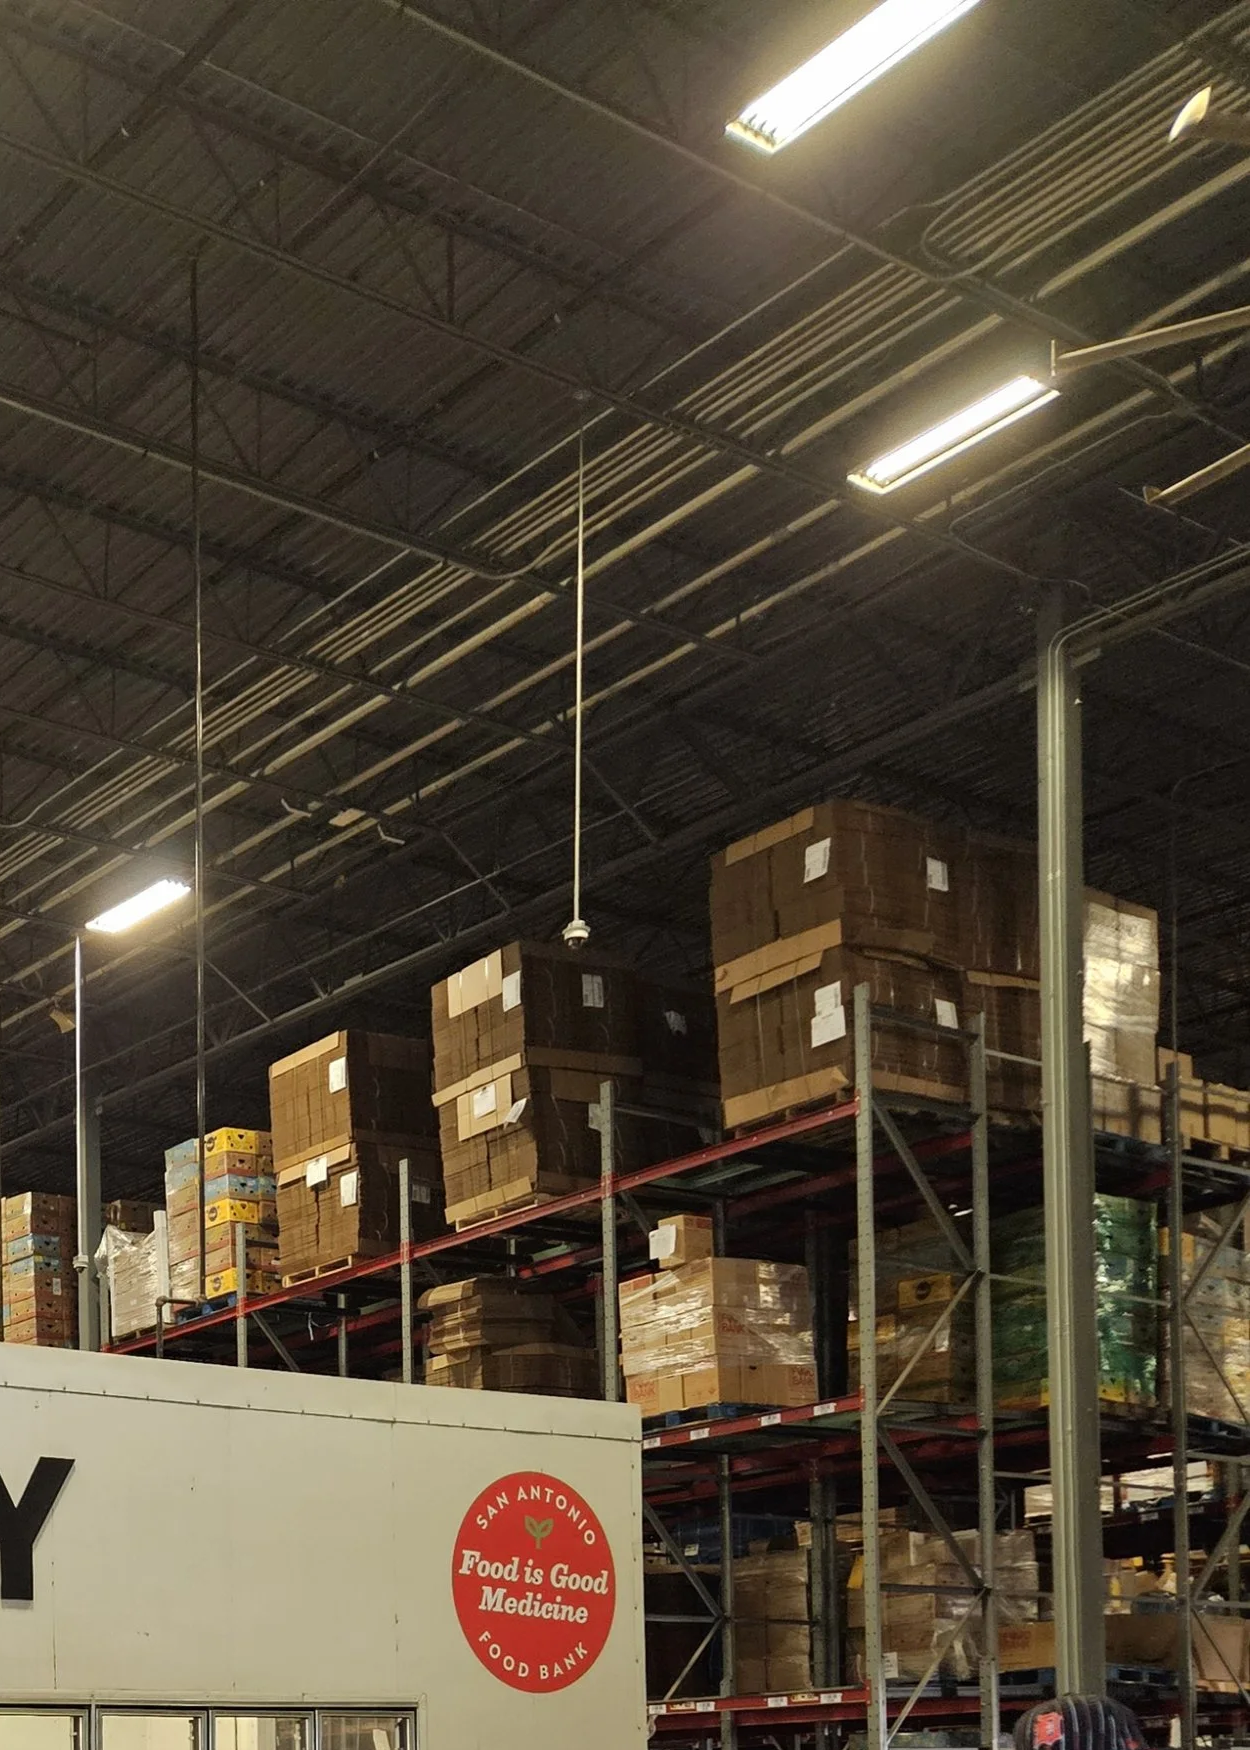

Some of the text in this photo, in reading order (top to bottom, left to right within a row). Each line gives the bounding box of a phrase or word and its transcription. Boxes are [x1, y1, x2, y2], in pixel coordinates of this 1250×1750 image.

[476, 1485, 596, 1546] SAN ANTONIO
[459, 1549, 609, 1595] Food is Good
[479, 1586, 589, 1625] Medicine
[479, 1630, 588, 1680] FOOD BANK
